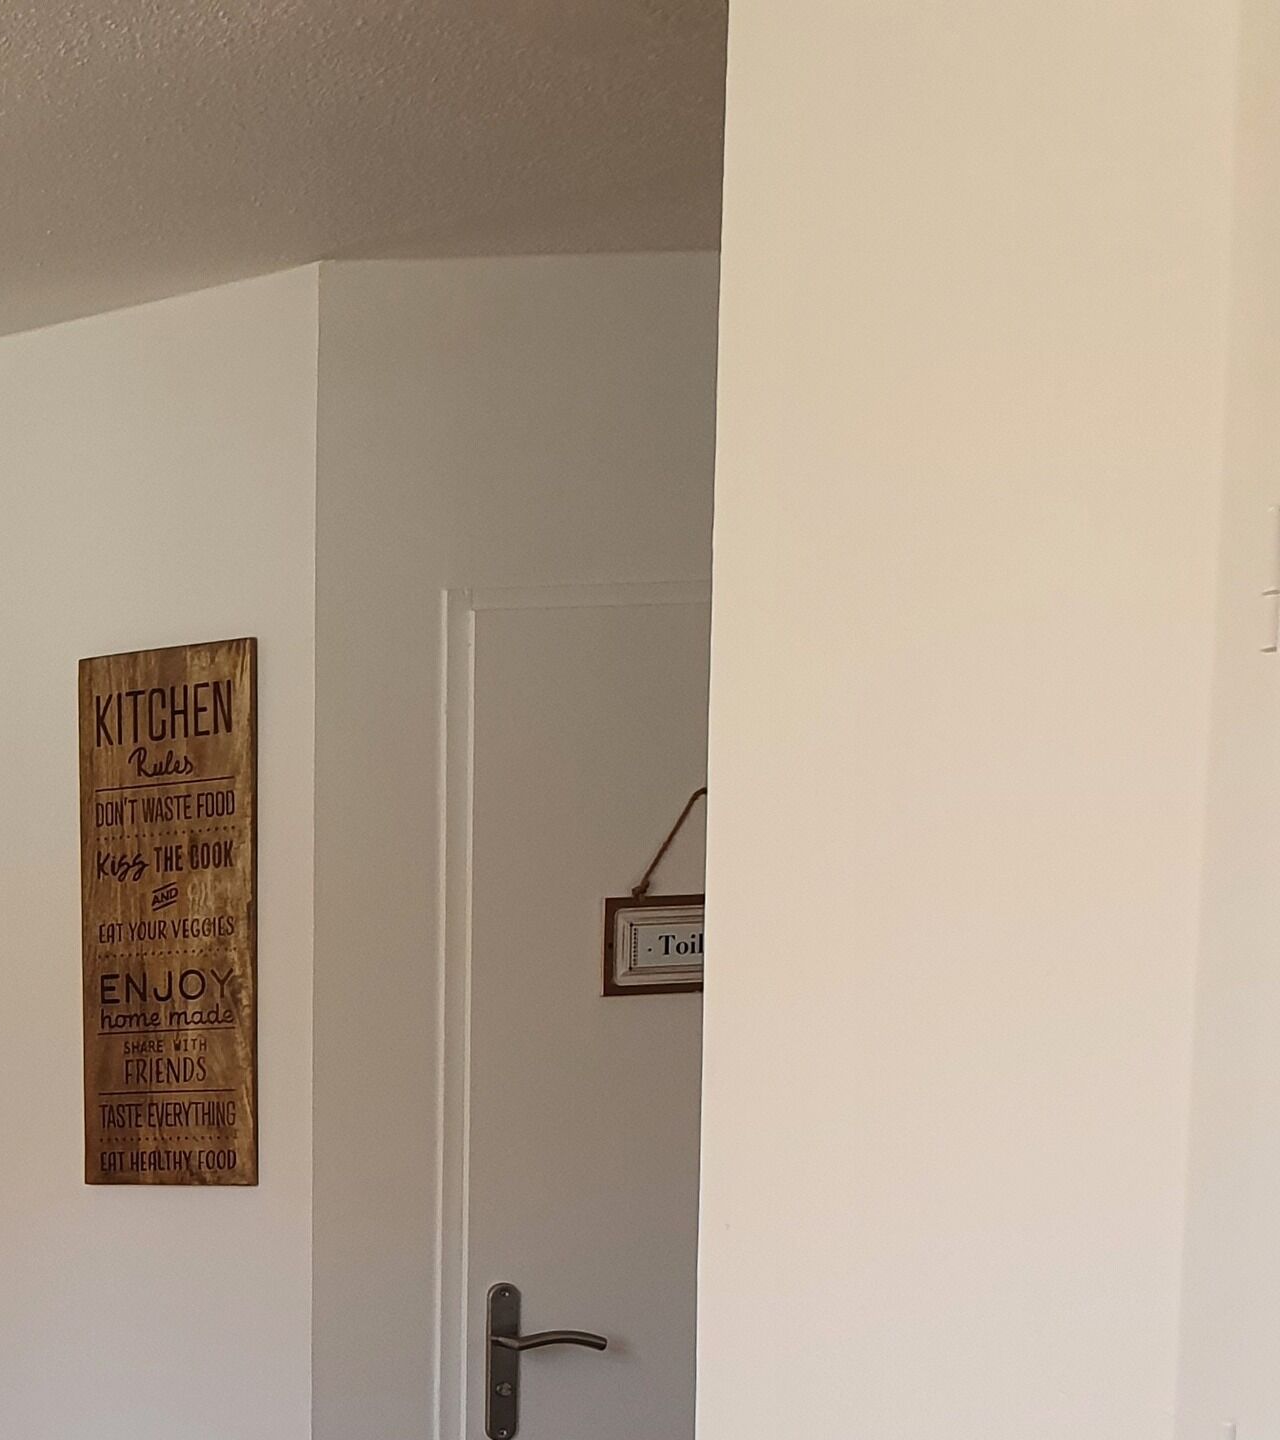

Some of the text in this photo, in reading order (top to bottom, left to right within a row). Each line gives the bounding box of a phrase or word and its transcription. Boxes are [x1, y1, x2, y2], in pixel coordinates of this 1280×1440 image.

[95, 680, 232, 747] KITCHEN
[128, 747, 194, 777] Rules
[95, 790, 235, 827] DON'T WASTE FOOD
[97, 840, 234, 882] Kiss THE COOK
[152, 888, 179, 905] AND
[99, 916, 234, 944] EAT YOUR VEGGIES
[100, 968, 234, 1004] ENJOY
[100, 1003, 234, 1029] home made
[124, 1039, 207, 1054] SHARE WITH
[124, 1057, 206, 1084] FRIENDS
[99, 1100, 235, 1129] TASTE EVERYTHING
[100, 1150, 236, 1172] EAT HEALTHY FOOD
